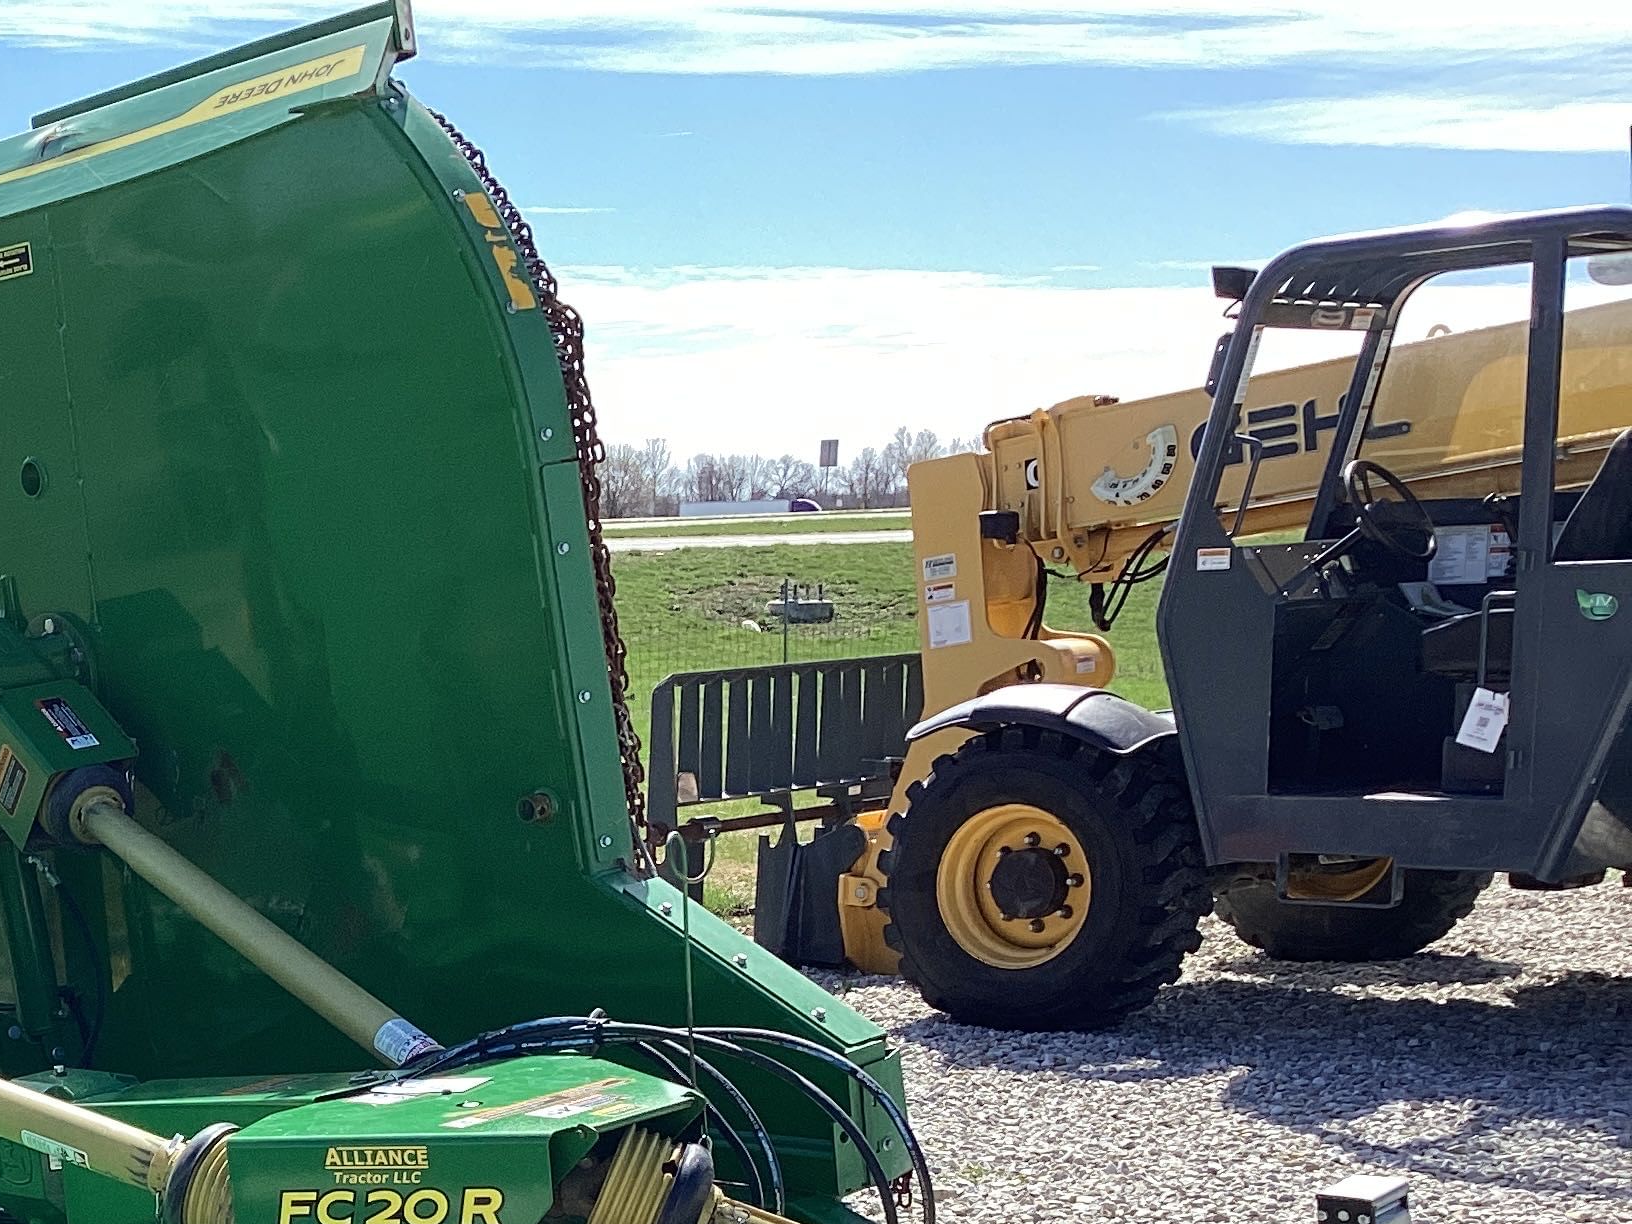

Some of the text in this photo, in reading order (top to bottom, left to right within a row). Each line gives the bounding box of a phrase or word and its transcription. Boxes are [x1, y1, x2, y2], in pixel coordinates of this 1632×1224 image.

[214, 59, 345, 109] JOHN DEERE
[325, 1147, 429, 1166] ALLIANCE
[334, 1172, 422, 1184] Tractor LLC
